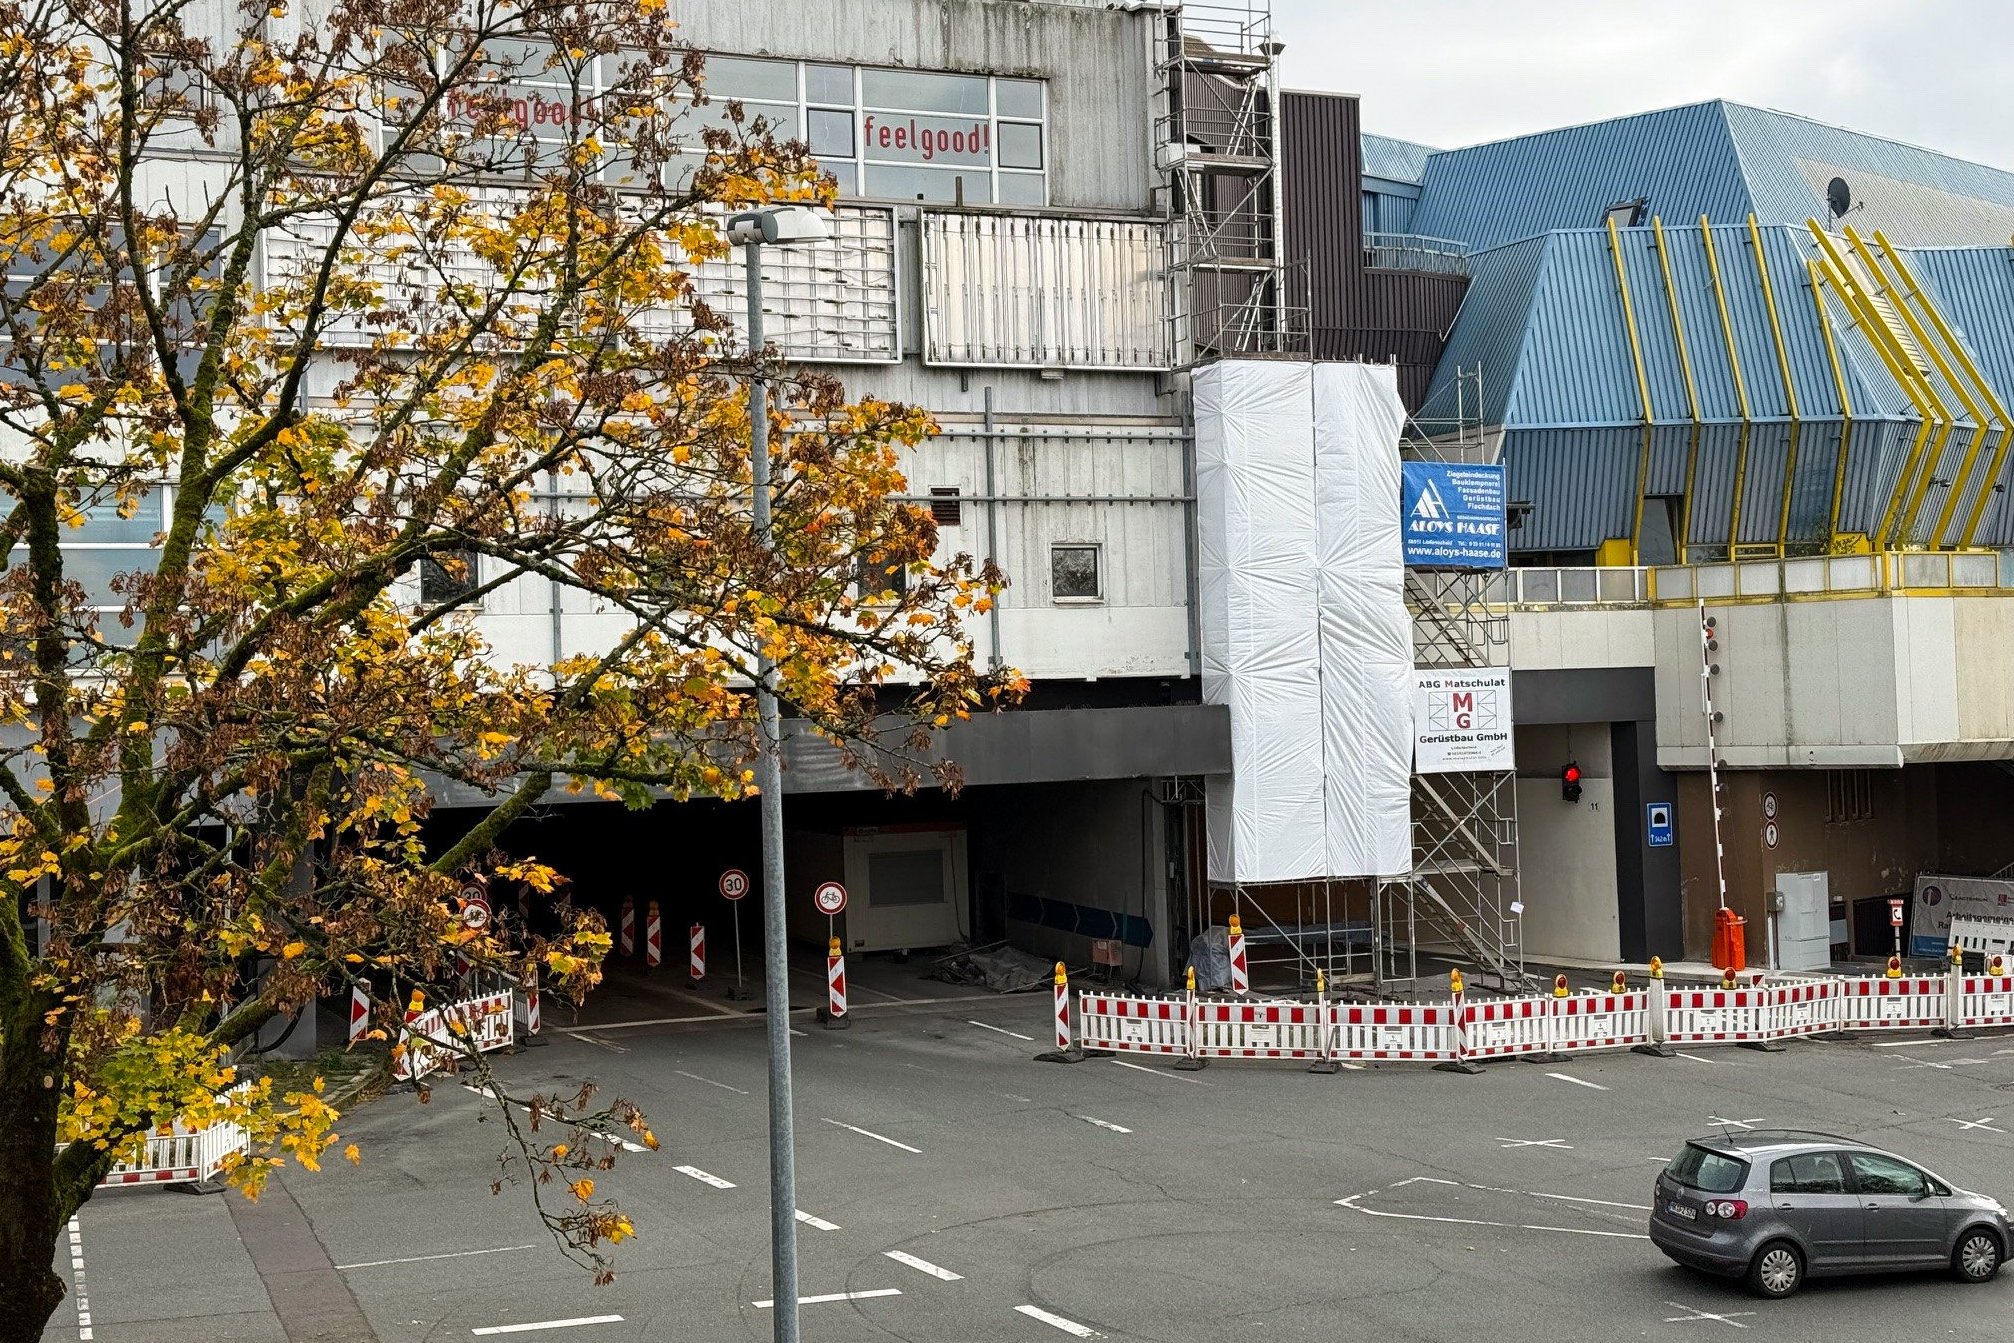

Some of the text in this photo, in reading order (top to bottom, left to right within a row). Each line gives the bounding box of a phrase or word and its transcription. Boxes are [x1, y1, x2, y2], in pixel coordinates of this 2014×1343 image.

[865, 115, 989, 160] feelgood!
[1452, 479, 1500, 488] Bauklempnerei
[1457, 487, 1500, 495] Fassadenbau
[1463, 495, 1500, 503] Gerüstbau
[1408, 520, 1500, 535] ALOYS HAASE
[1408, 547, 1501, 558] www.aloys-haase.de
[1419, 679, 1505, 688] ABG Matschulat
[1453, 692, 1473, 712] M
[1456, 713, 1471, 729] G
[1420, 733, 1507, 743] Gerüstbau GmbH
[1591, 802, 1598, 810] 11
[726, 878, 742, 891] 30
